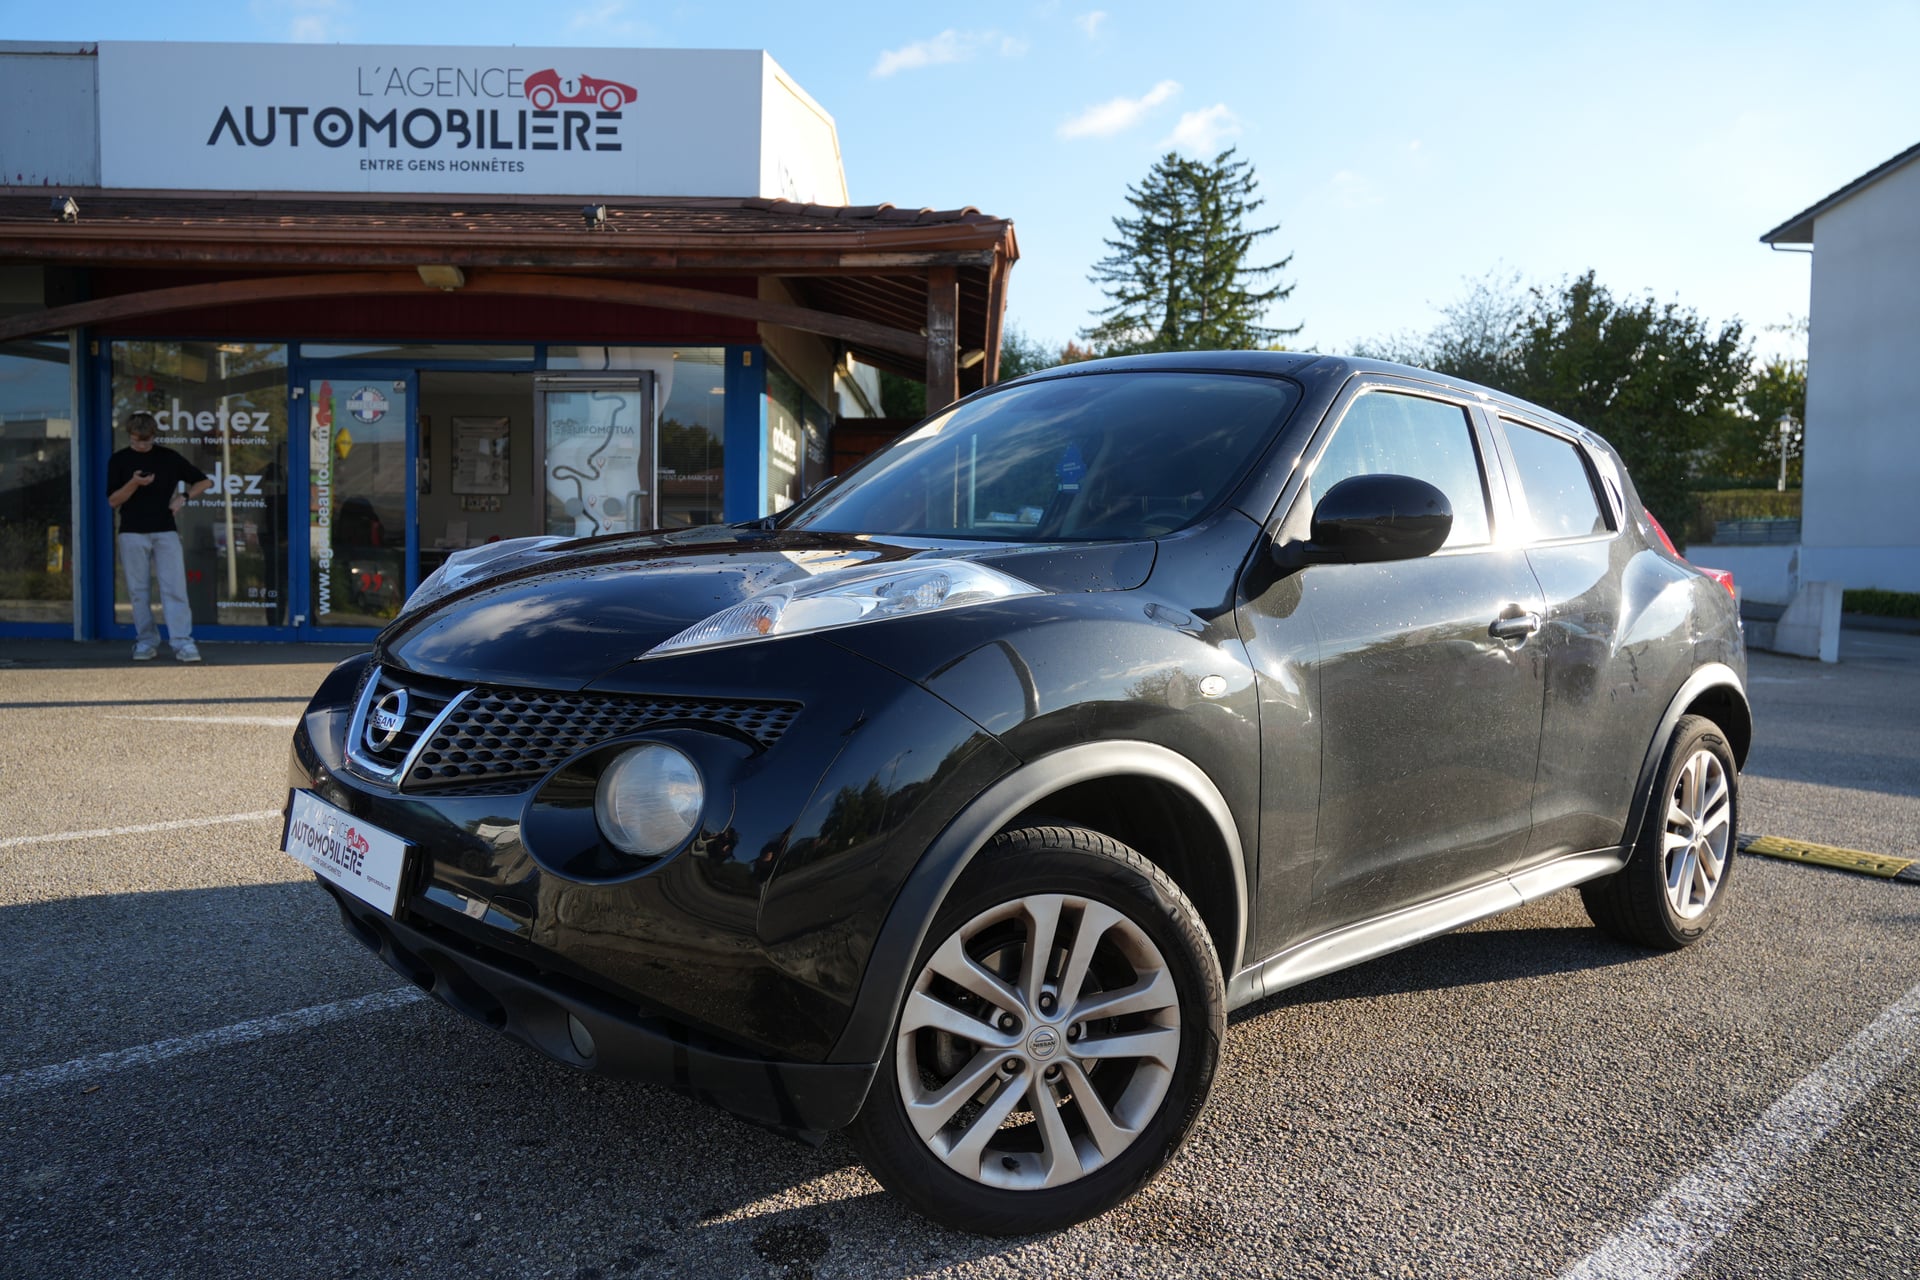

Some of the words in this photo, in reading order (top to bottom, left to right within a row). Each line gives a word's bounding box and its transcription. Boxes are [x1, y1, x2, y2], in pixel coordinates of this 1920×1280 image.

[358, 66, 525, 98] L'AGENCE
[565, 79, 573, 94] 1
[206, 105, 623, 152] AUTOMOBILIERE
[359, 159, 404, 172] ENTRE
[407, 159, 446, 172] GENS
[449, 157, 525, 173] HONNÊTES
[134, 398, 270, 432] chetez
